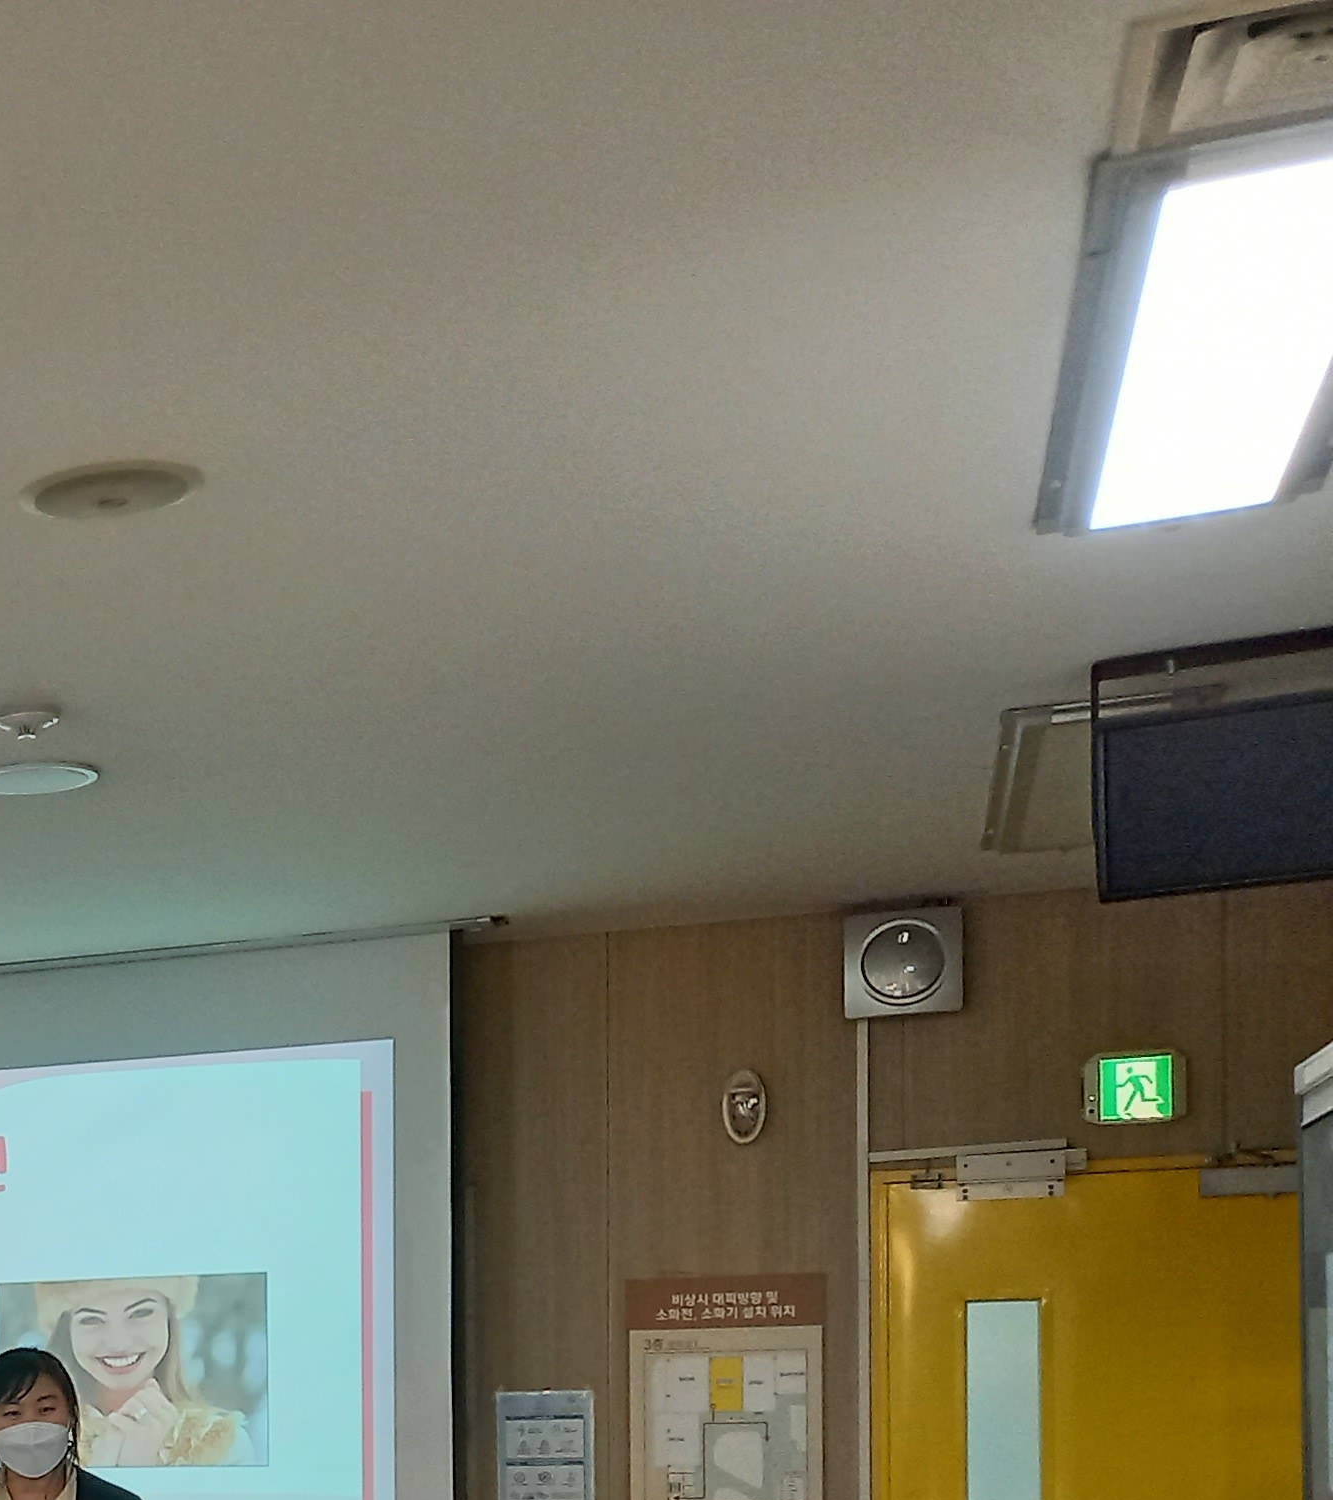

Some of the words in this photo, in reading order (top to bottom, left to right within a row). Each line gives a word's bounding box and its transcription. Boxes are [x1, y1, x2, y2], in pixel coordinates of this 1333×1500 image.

[671, 1293, 708, 1307] 비상시
[712, 1291, 762, 1306] 대피방향
[765, 1290, 779, 1304] 및
[655, 1308, 697, 1321] 소화전,
[701, 1306, 738, 1319] 소화기
[742, 1305, 767, 1319] 설치
[770, 1304, 796, 1318] 위치
